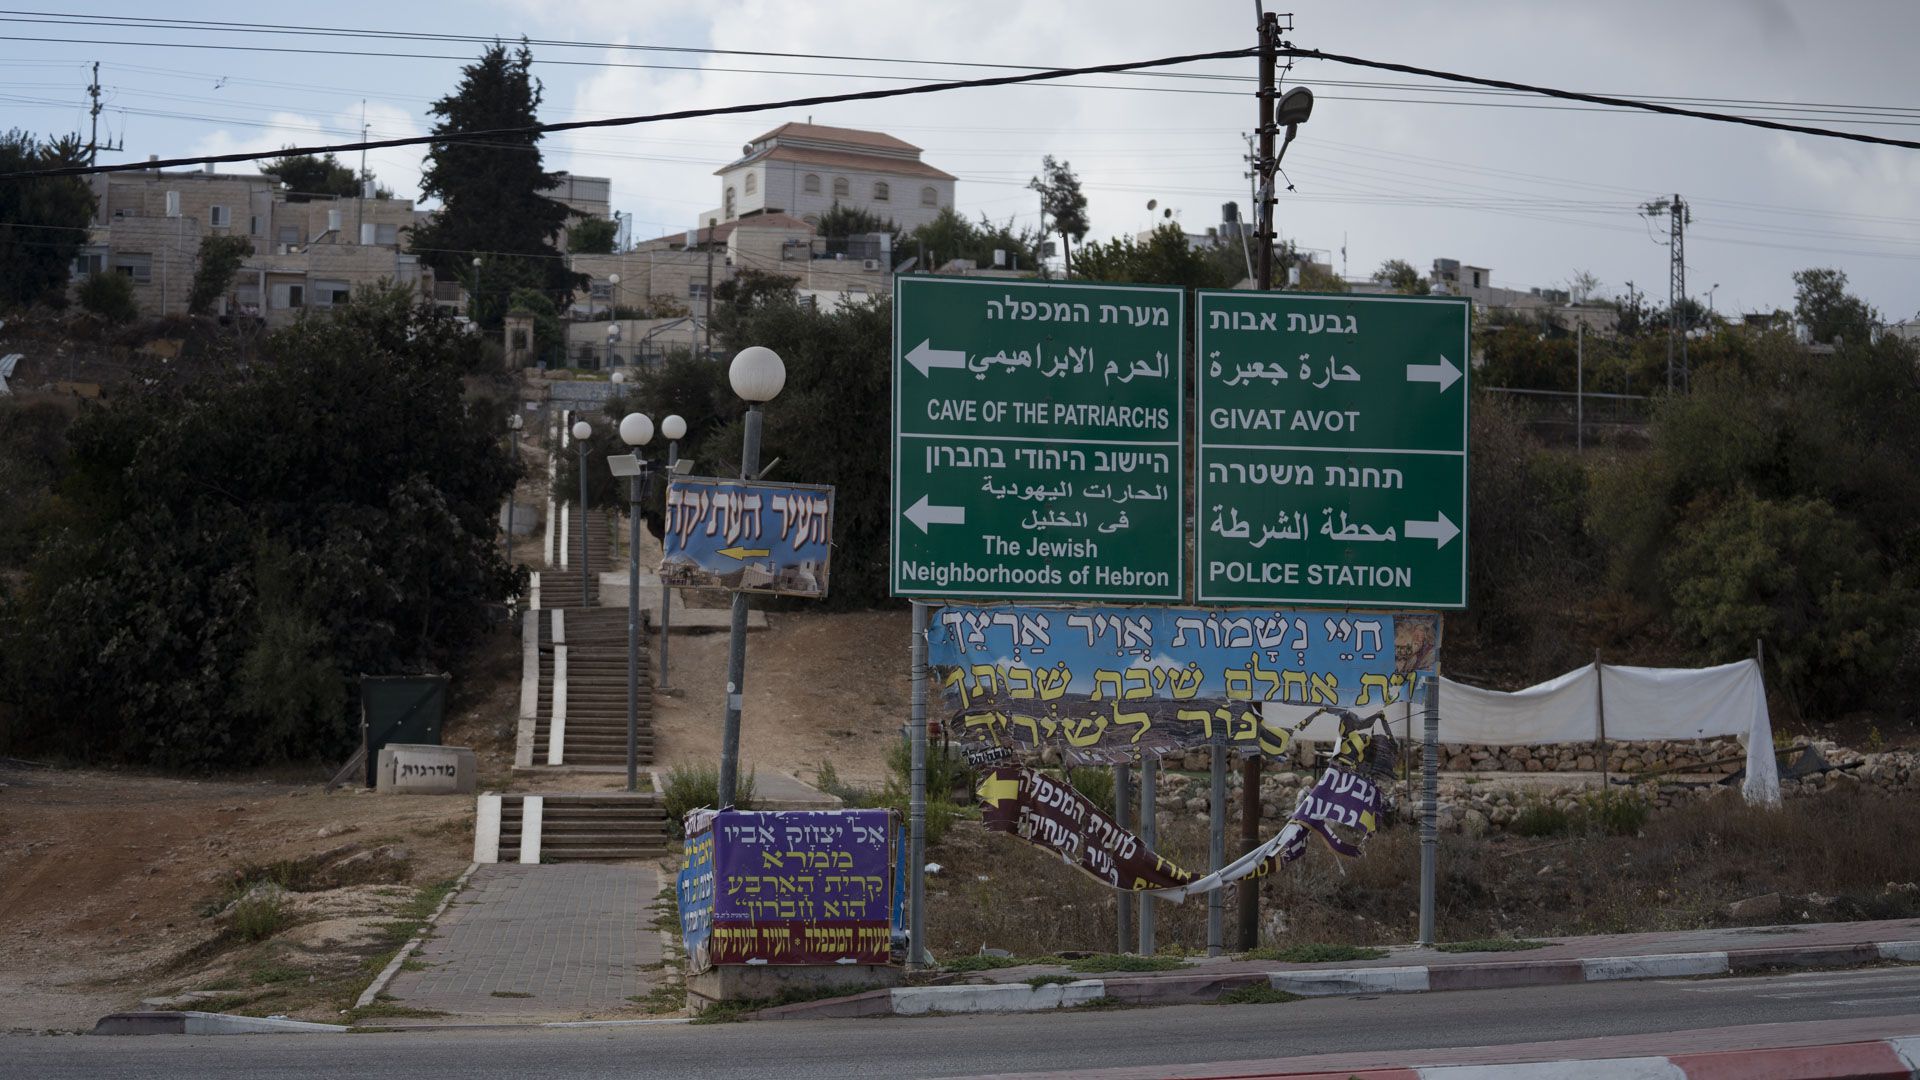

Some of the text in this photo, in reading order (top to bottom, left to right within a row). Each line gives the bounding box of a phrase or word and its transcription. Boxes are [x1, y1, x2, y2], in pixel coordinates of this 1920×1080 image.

[987, 294, 1169, 327] מערת המכפלה
[1209, 310, 1358, 335] גבעת אבות
[968, 342, 1169, 387] الحرم الابراهيمي
[1209, 350, 1361, 389] حارة جعبرة
[927, 398, 1169, 430] CAVE OF THE PATRIARCHS
[1210, 407, 1361, 432] GIVAT AVOT
[926, 445, 1169, 474] היישוב היהודי בחברון
[981, 475, 1168, 504] الحارات اليهودية
[1209, 462, 1403, 489] תחנת משטרה
[665, 487, 829, 550] העיר העתיקה
[1021, 509, 1088, 531] الخليل
[1210, 503, 1397, 548] محطة الشرطة
[982, 534, 1098, 558] The Jewish
[902, 560, 1169, 587] Neighborhoods of Hebron
[1209, 561, 1411, 588] POLICE STATION
[401, 763, 457, 778] מדרגות
[1318, 767, 1377, 807] גבעת
[713, 917, 889, 961] מערת המכפלה העיר העתיקה
